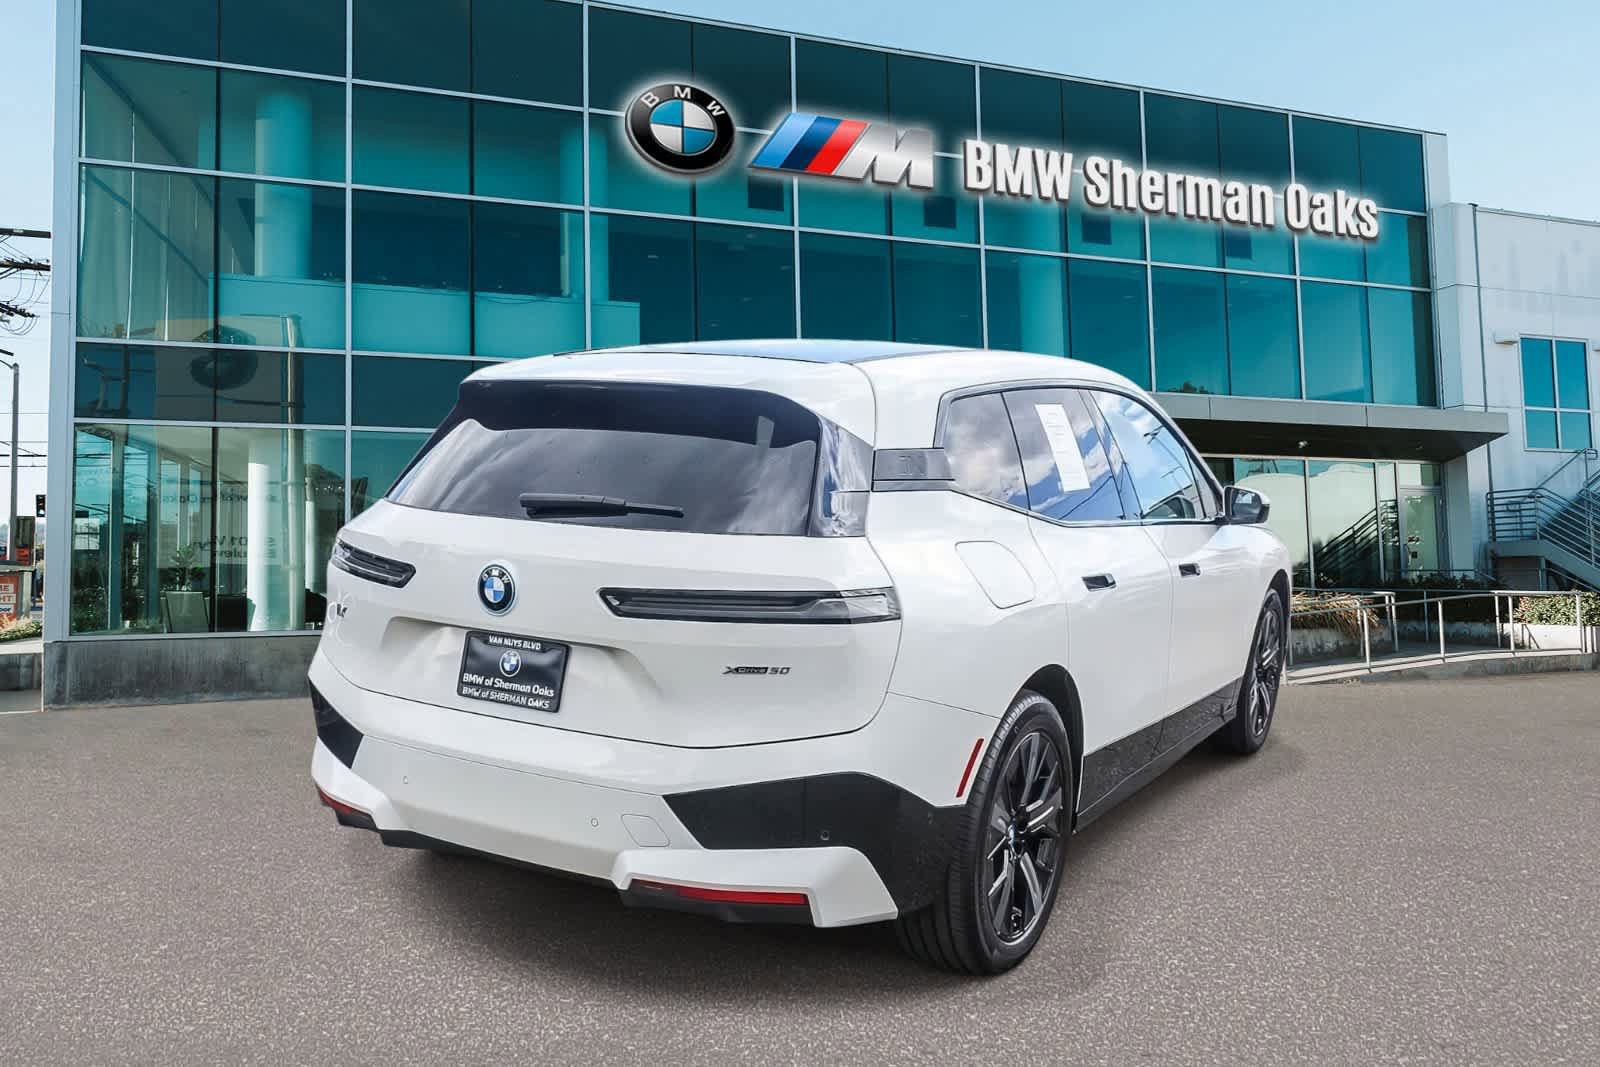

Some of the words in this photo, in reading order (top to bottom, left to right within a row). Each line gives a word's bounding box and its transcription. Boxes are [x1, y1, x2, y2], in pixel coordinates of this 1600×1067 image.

[641, 85, 725, 117] BMW
[964, 139, 1073, 203] BMW
[1083, 156, 1275, 228] Sherman
[1284, 183, 1379, 240] Oaks
[489, 635, 503, 644] VAN
[504, 638, 522, 647] NUYS
[523, 640, 541, 650] BLVD
[463, 673, 484, 685] BMW
[484, 677, 494, 686] of
[494, 678, 531, 693] Sherman
[532, 684, 554, 697] Oaks
[462, 686, 481, 697] BMW
[481, 690, 490, 698] of
[489, 691, 527, 705] SHERMAN
[528, 698, 551, 709] OAKS
